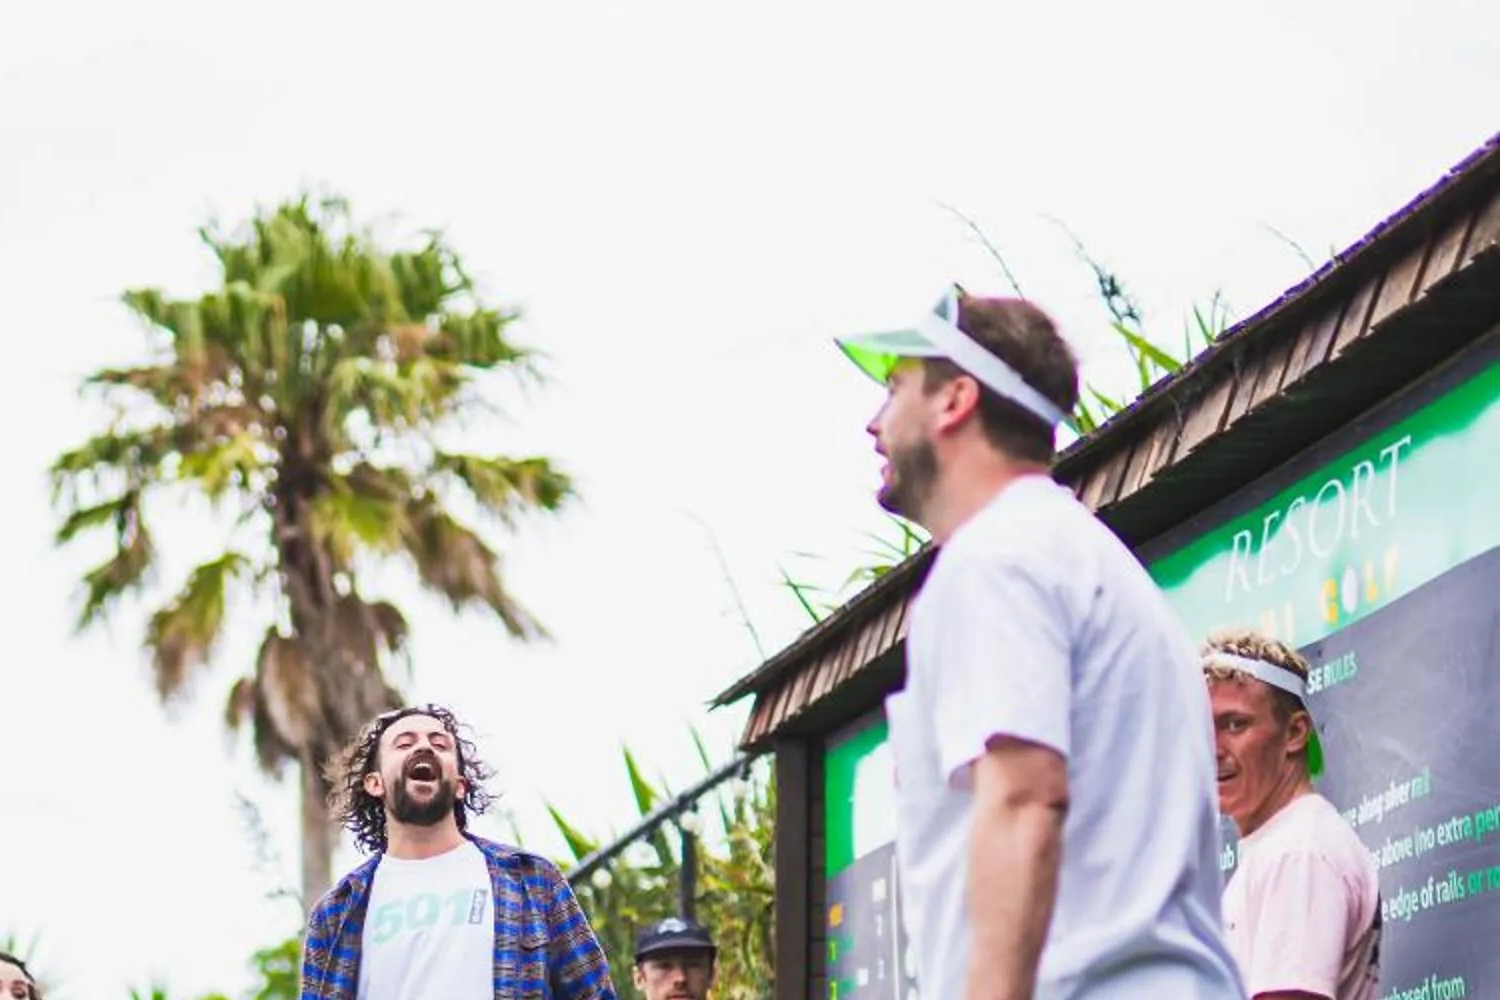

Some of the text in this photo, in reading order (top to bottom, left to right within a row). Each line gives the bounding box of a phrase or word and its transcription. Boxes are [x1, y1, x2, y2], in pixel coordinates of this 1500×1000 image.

[1225, 435, 1412, 602] RESORT
[1436, 815, 1473, 846] extra
[371, 889, 471, 944] 501
[1389, 885, 1419, 921] edge
[1419, 874, 1435, 910] of
[1435, 867, 1466, 904] rails
[1467, 871, 1483, 896] or
